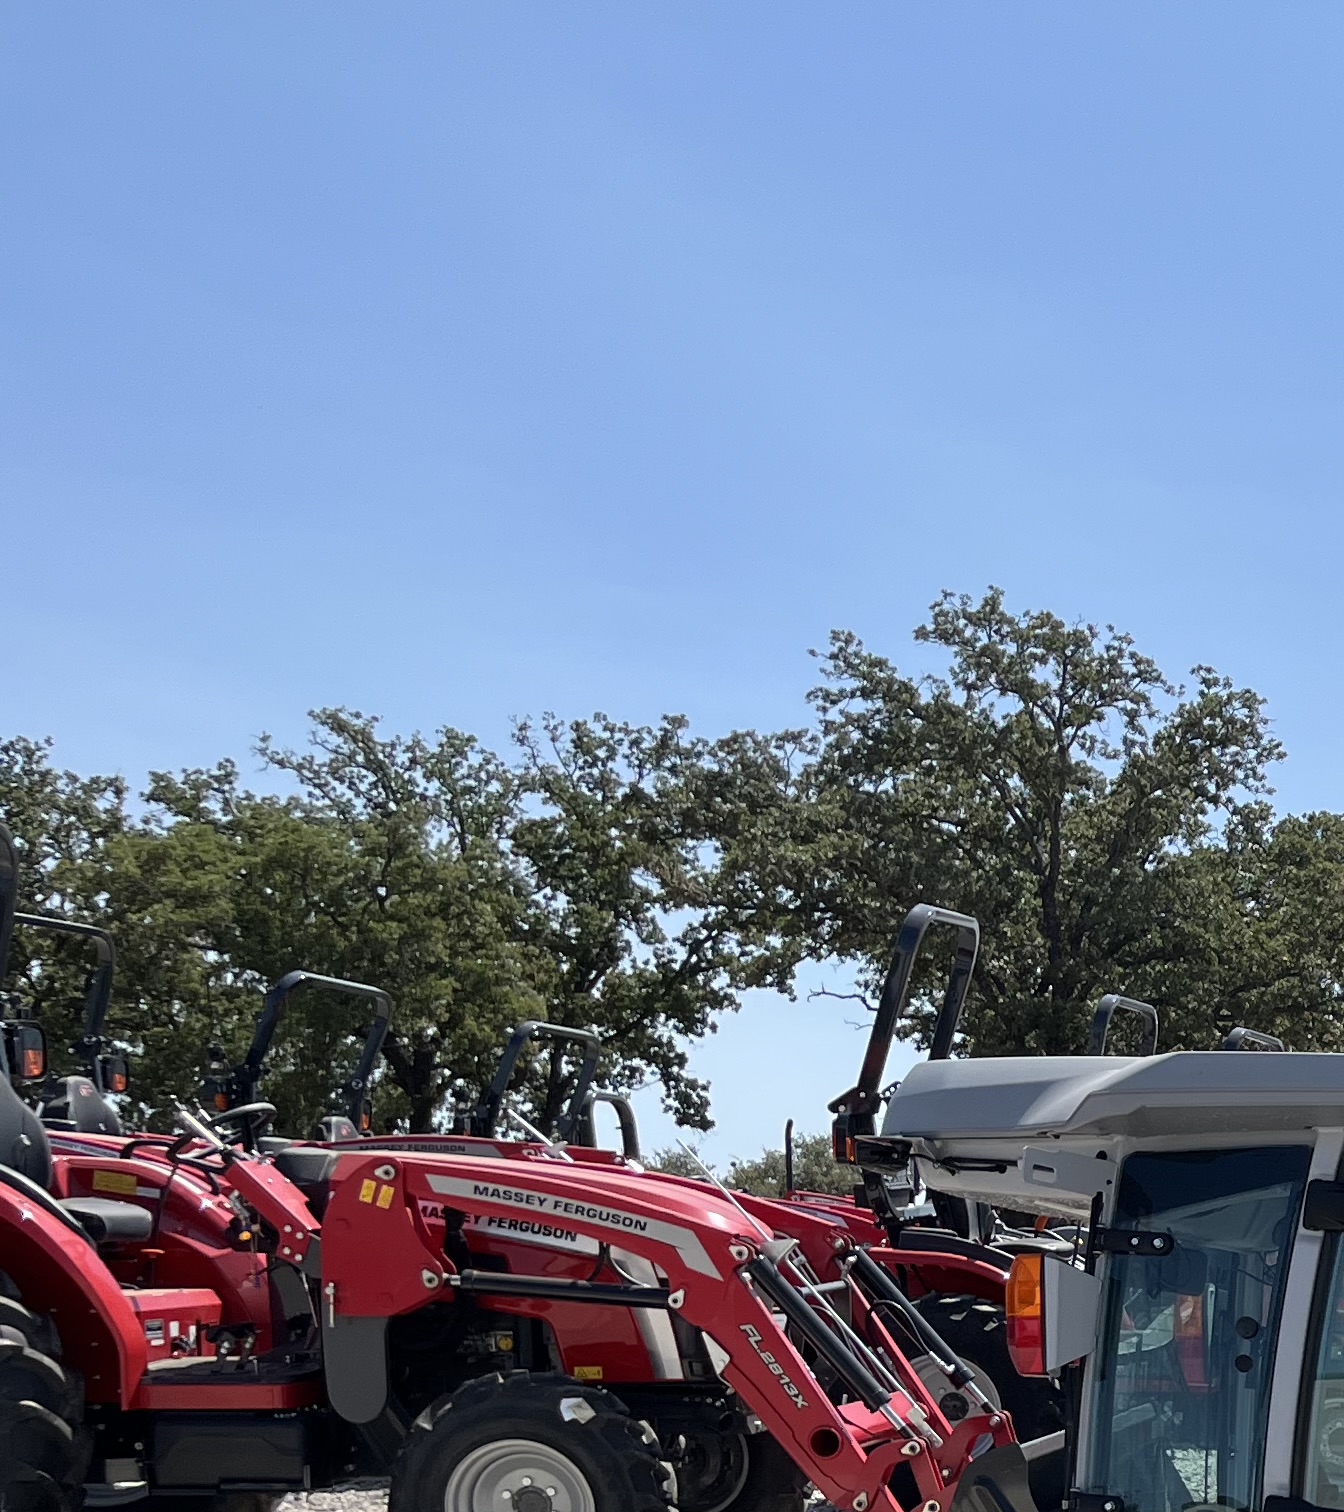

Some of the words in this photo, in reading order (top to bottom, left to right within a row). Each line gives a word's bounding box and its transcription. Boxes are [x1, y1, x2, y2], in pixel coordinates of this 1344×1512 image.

[473, 1184, 548, 1207] MASSEY
[552, 1201, 648, 1231] FERGUSON
[487, 1215, 577, 1242] FERGUSON
[739, 1323, 809, 1409] FL.2813X
